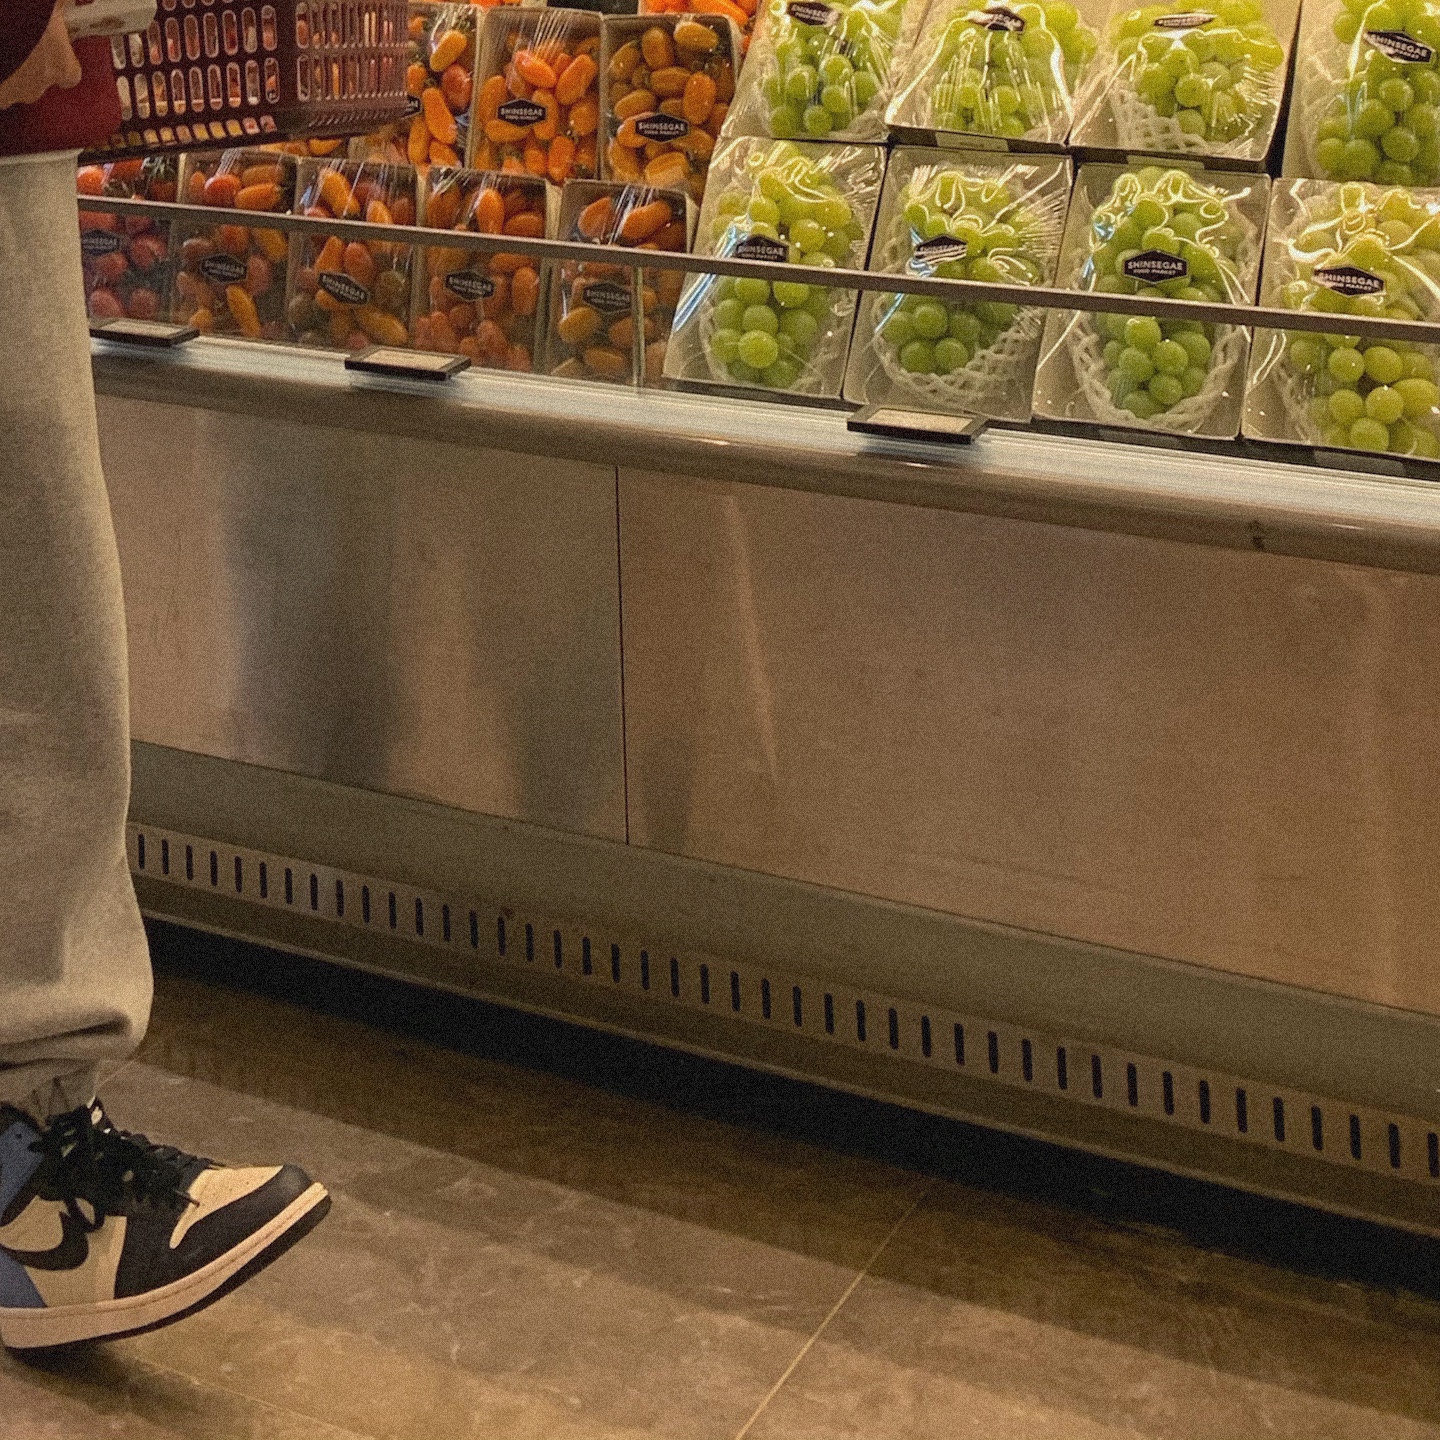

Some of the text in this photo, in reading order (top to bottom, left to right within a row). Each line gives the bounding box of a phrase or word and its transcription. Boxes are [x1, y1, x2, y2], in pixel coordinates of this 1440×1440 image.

[639, 122, 686, 132] SHINSEGAE
[1127, 260, 1183, 271] SHINSEGAE
[1318, 272, 1380, 288] SHINSEGAE
